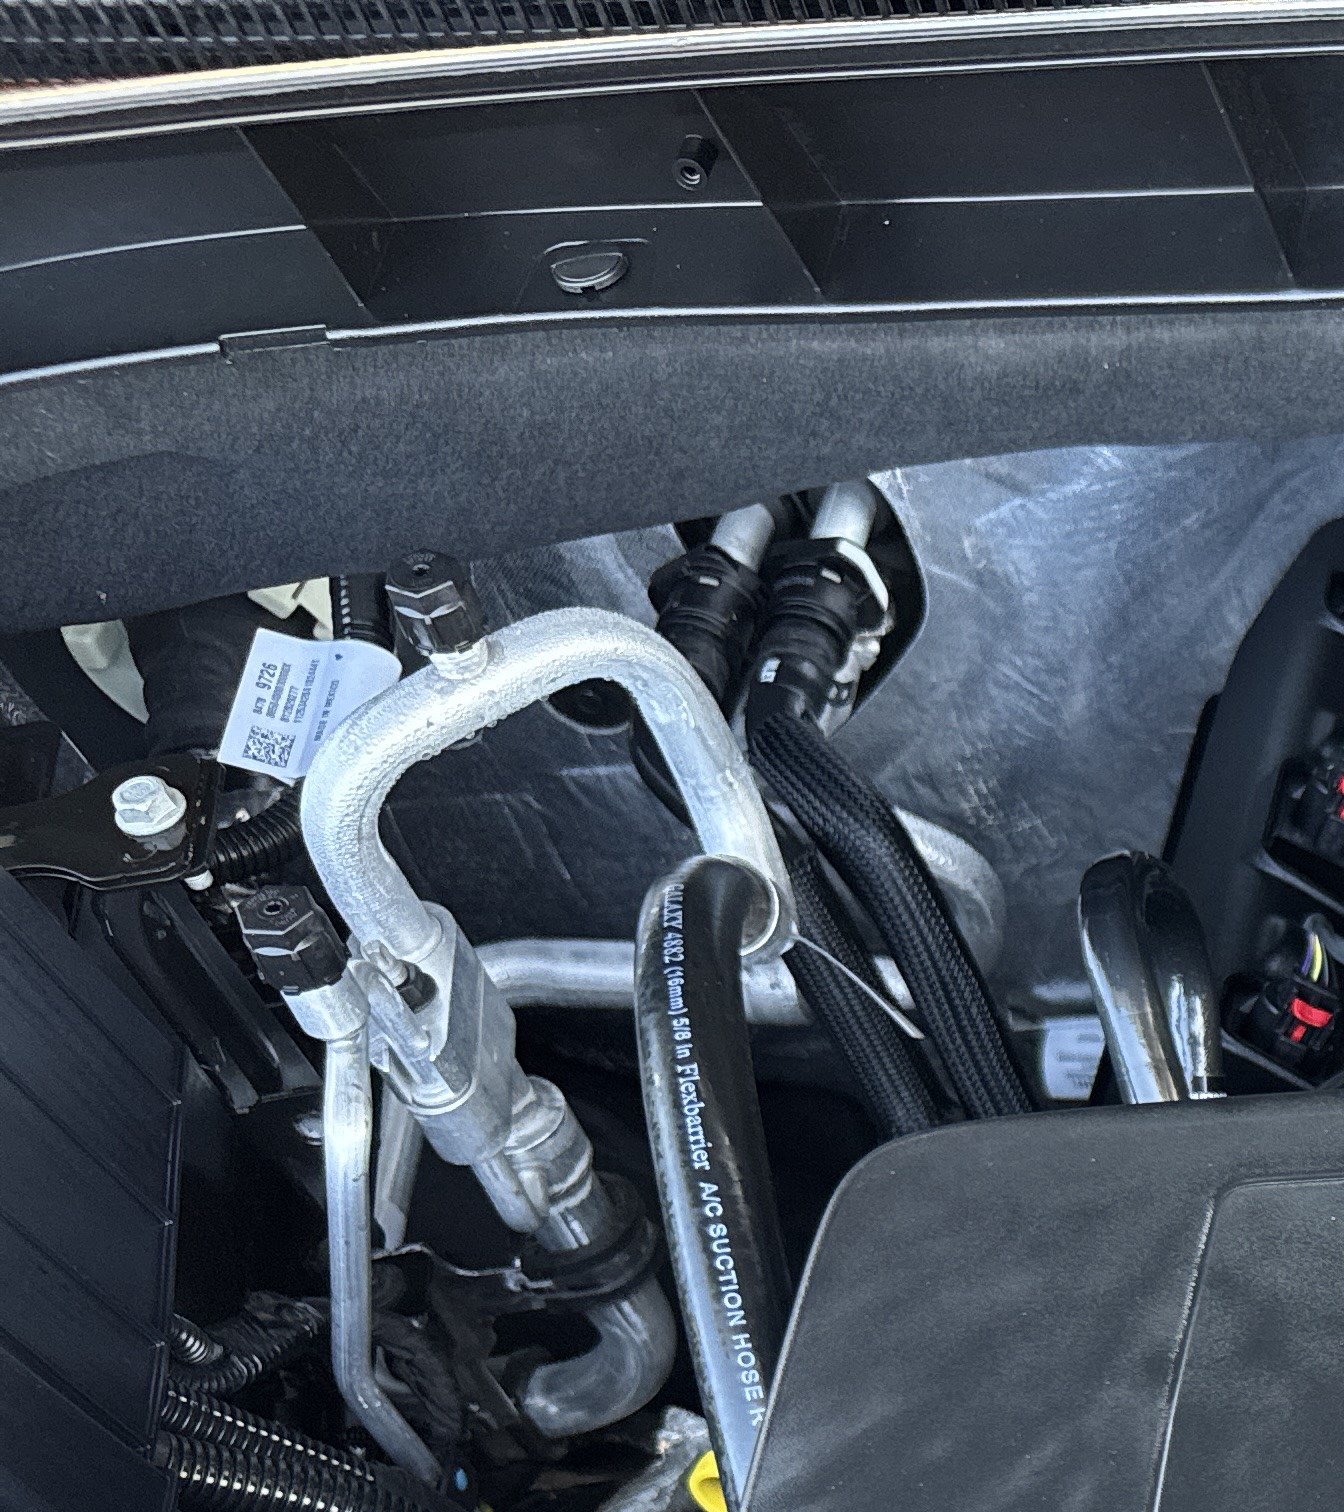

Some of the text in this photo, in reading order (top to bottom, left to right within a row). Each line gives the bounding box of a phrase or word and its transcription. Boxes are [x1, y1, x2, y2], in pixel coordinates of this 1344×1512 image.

[255, 662, 278, 691] 9726
[663, 932, 685, 964] 4882
[663, 965, 689, 1016] (16mm)
[672, 1017, 693, 1041] 5/8
[675, 1062, 713, 1171] Flexbarrier
[699, 1181, 724, 1218] A/C
[707, 1223, 747, 1328] SUCTION
[731, 1333, 765, 1402] HOSE
